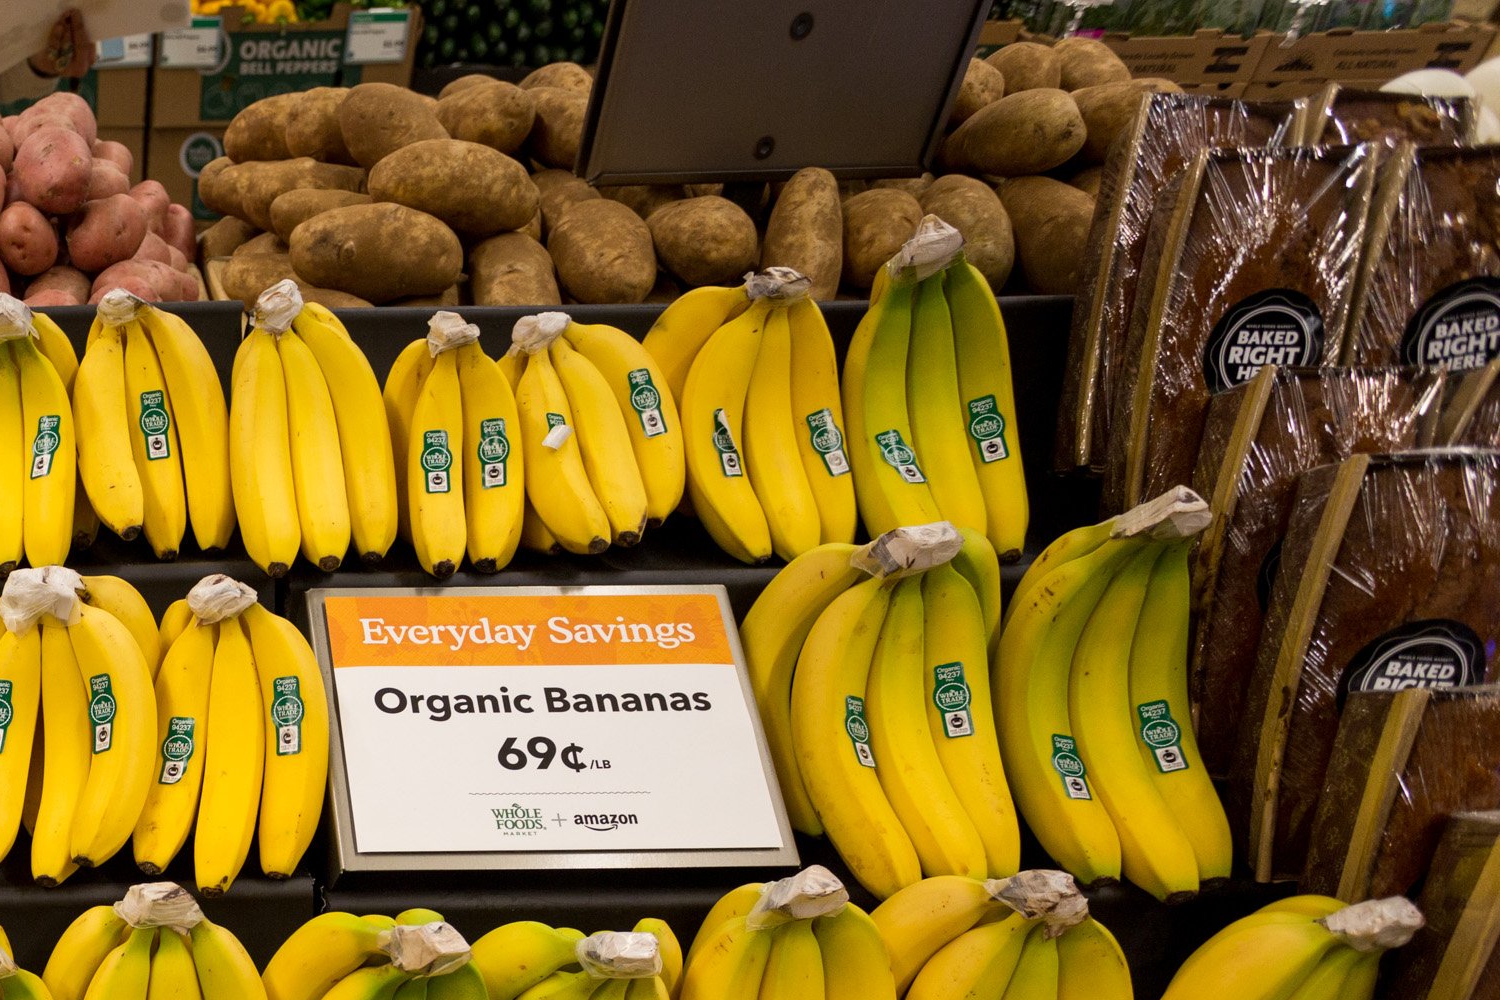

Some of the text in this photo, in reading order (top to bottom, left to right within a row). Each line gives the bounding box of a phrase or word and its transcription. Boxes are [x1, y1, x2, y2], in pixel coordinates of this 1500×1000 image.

[239, 38, 343, 60] ORGANIC
[239, 59, 339, 75] BELL PEPPERS
[1435, 314, 1499, 339] BAKED
[1237, 330, 1299, 346] BAKED
[1227, 346, 1300, 366] RIGHT
[360, 616, 696, 651] Everyday Savings
[936, 664, 960, 673] Organic
[938, 671, 960, 680] 94237
[1385, 660, 1456, 680] BAKED
[940, 690, 964, 699] WHOLE
[941, 696, 965, 705] TRADE
[374, 686, 712, 722] Organic Bananas
[491, 806, 543, 820] WHOLE
[573, 812, 638, 826] amazon
[496, 818, 543, 831] FOODS
